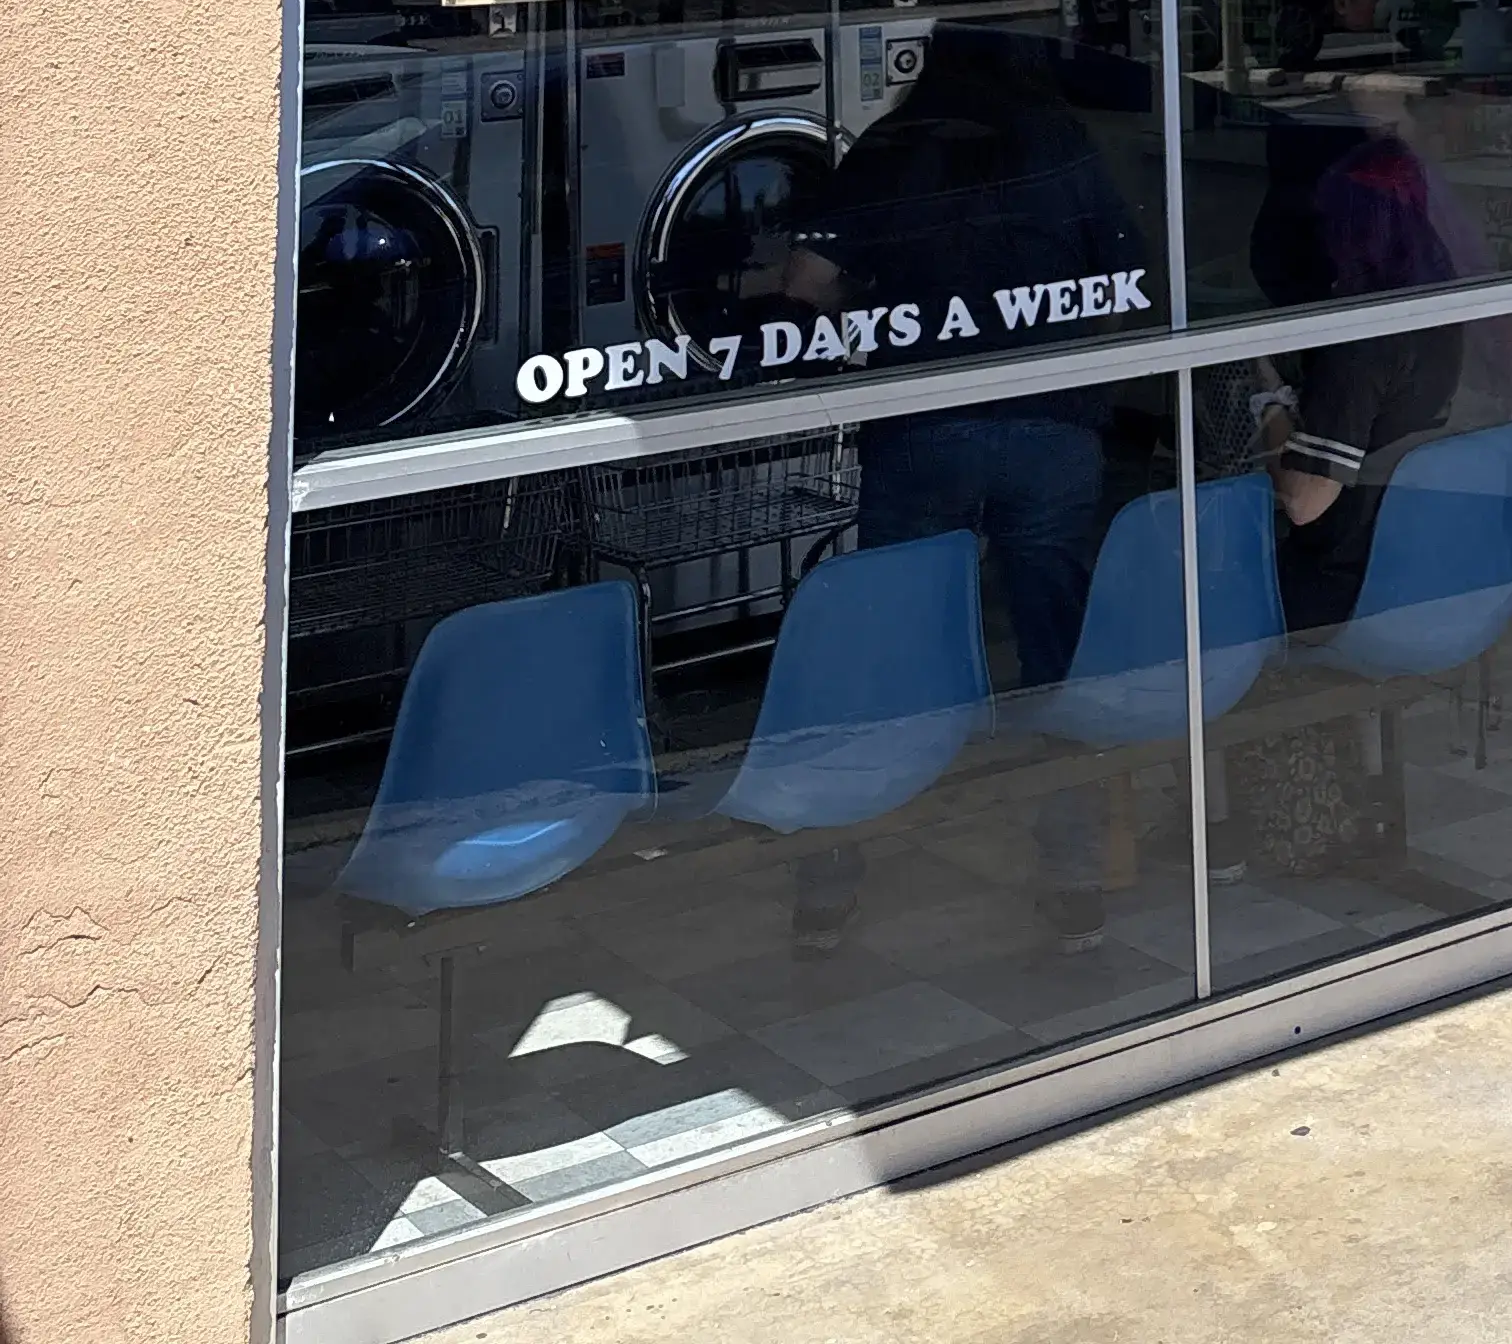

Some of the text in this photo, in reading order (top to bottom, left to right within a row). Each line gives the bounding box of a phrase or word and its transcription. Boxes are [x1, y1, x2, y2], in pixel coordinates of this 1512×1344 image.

[516, 269, 1153, 404] OPEN 7 DAYS A WEEK
